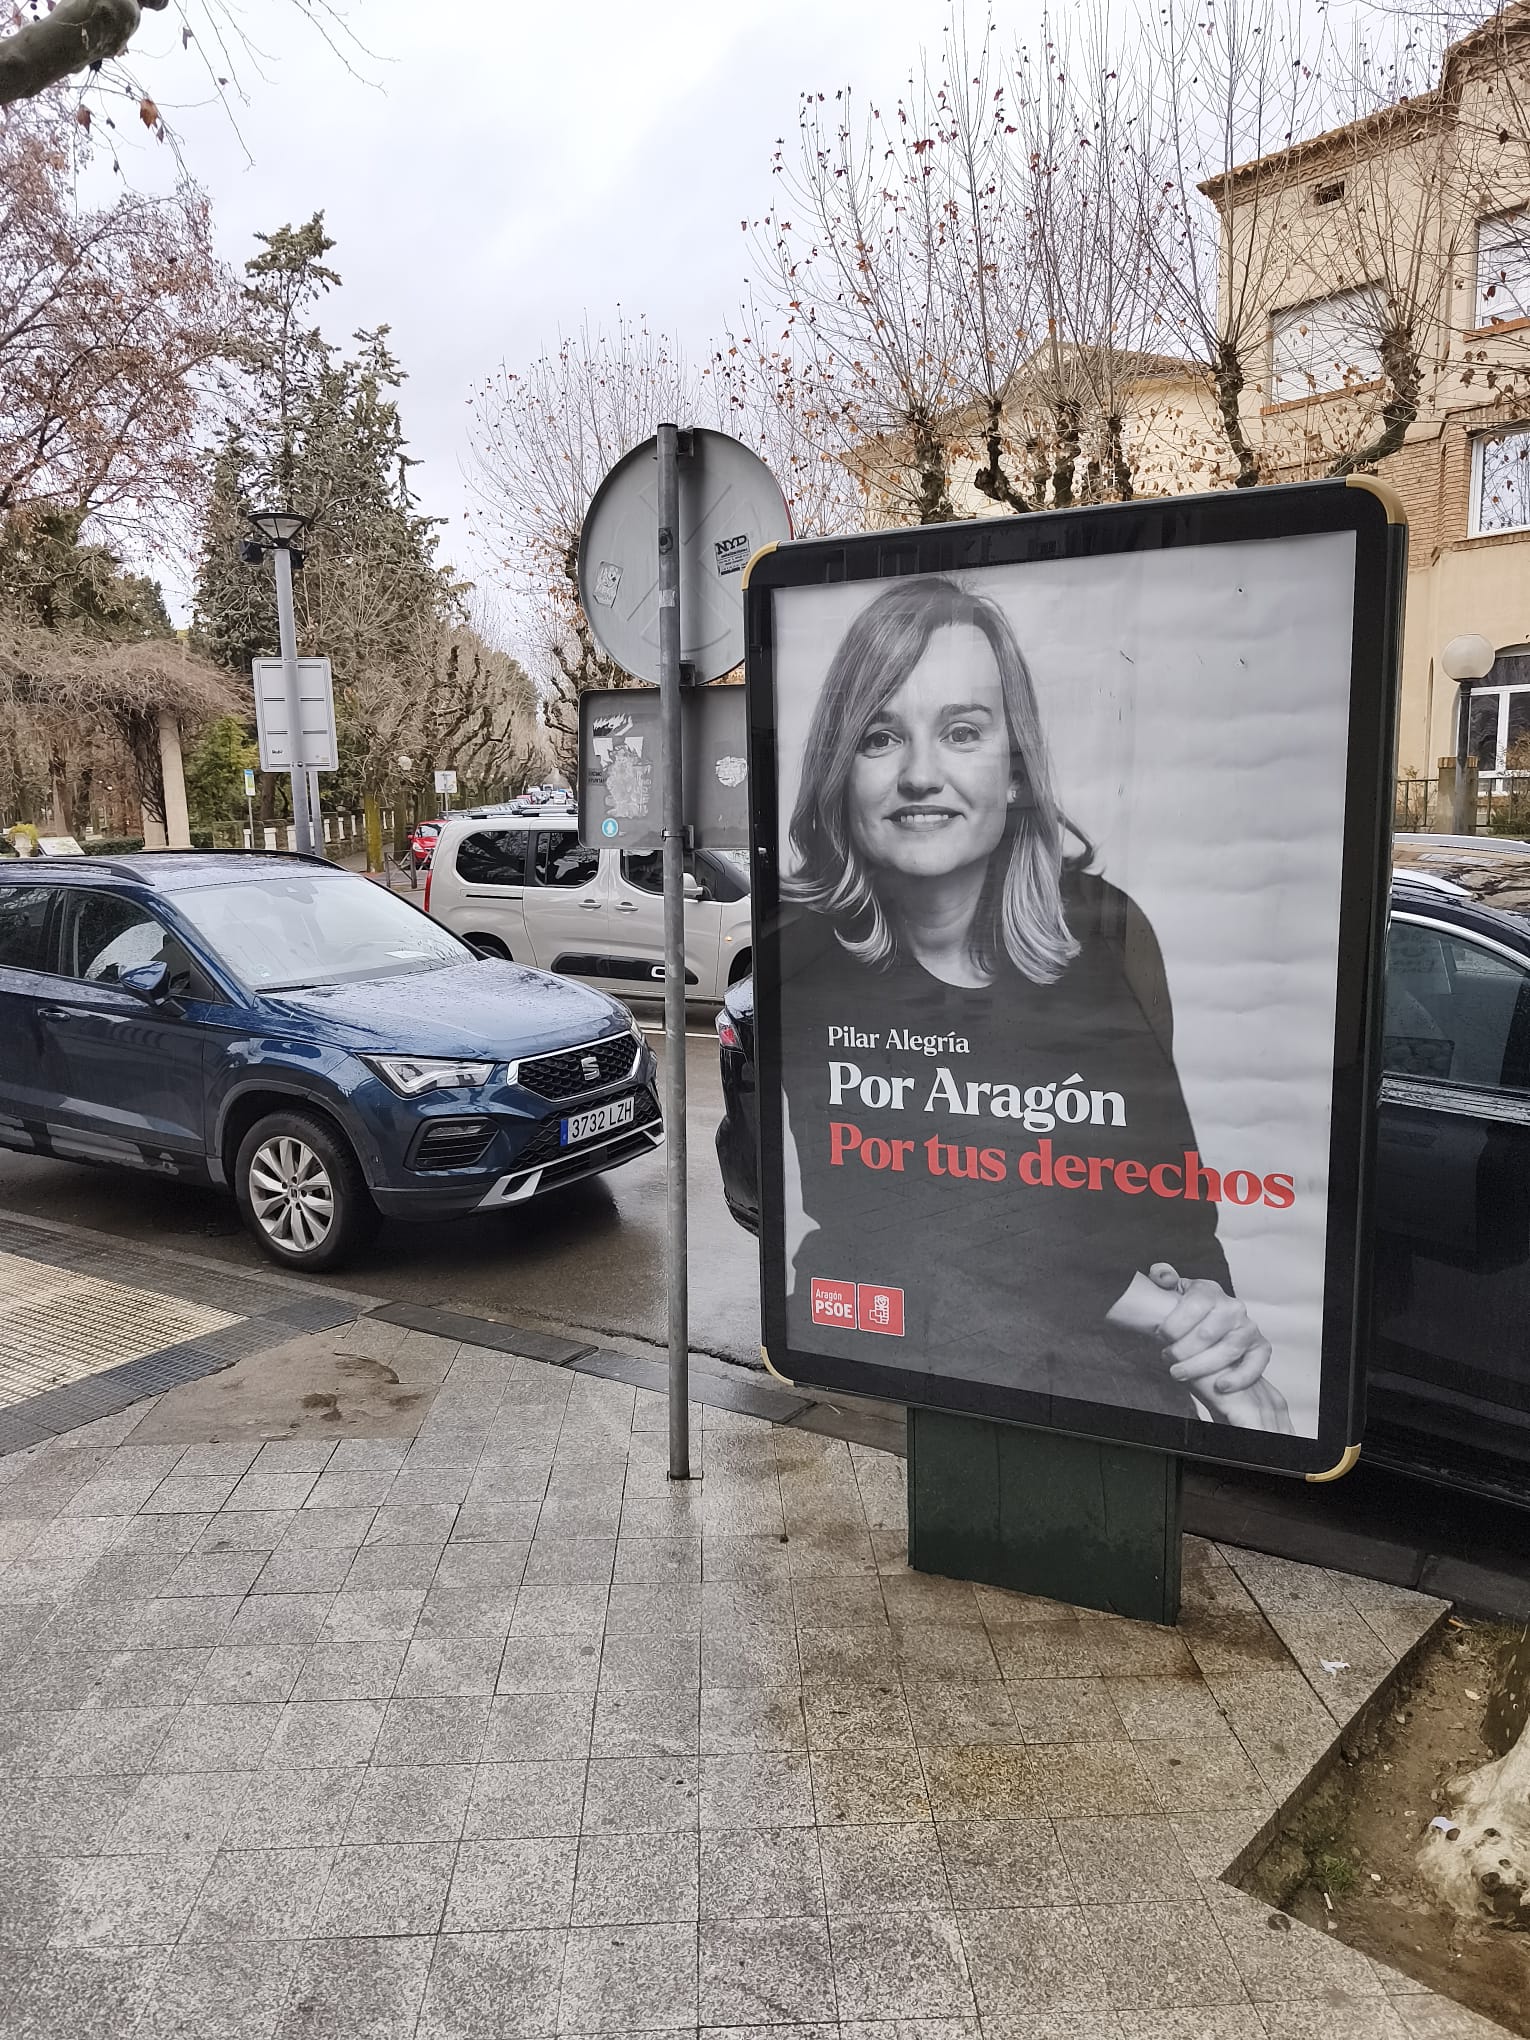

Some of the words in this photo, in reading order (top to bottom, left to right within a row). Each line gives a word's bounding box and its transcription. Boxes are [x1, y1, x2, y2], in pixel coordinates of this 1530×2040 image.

[715, 535, 747, 555] NYD
[827, 1026, 880, 1049] Pilar
[885, 1029, 970, 1056] Alegría
[828, 1061, 915, 1110] Por
[923, 1067, 1127, 1133] Aragón
[572, 1111, 605, 1138] 3732
[609, 1100, 632, 1126] LZH
[829, 1122, 914, 1171] Por
[923, 1134, 1007, 1182] tus
[1018, 1138, 1296, 1209] derechos
[816, 1288, 842, 1301] Aragón
[816, 1300, 852, 1318] PSOE
